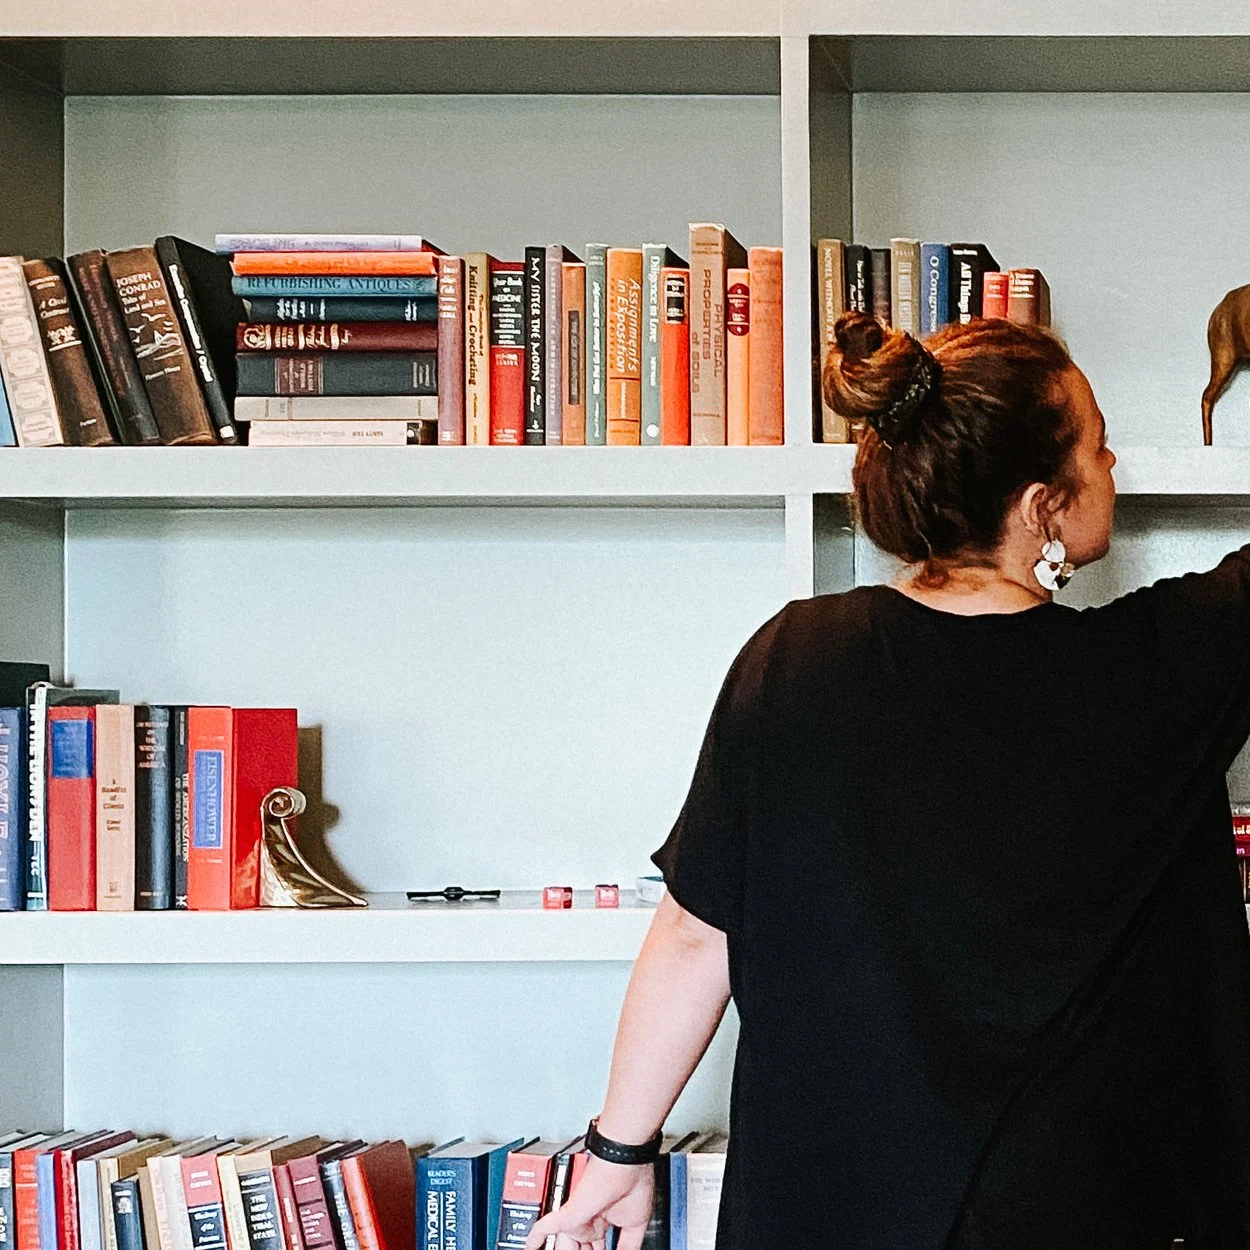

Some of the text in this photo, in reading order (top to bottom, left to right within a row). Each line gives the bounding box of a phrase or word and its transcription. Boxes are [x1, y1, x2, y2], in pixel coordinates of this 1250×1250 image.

[116, 272, 151, 288] JOSEPH
[119, 281, 161, 297] CONRAD
[247, 278, 411, 291] REFURBISHING ANTIQUES
[928, 255, 939, 332] O Congress
[960, 262, 972, 280] All
[530, 257, 541, 381] MY SISTER THE MOON
[648, 255, 660, 343] Diligence in Love
[702, 269, 711, 360] PROPERTIES
[958, 280, 972, 312] Things
[468, 265, 479, 386] Knitting Crocheting
[616, 280, 628, 373] in Exposition
[628, 278, 640, 372] Assignments
[713, 304, 723, 378] PHYSICAL
[692, 351, 701, 393] SOILS
[207, 756, 217, 841] EISENHOWER
[427, 1170, 456, 1178] READER'S
[335, 1193, 345, 1216] THE
[427, 1191, 438, 1237] MEDICAL
[445, 1191, 456, 1232] FAMILY
